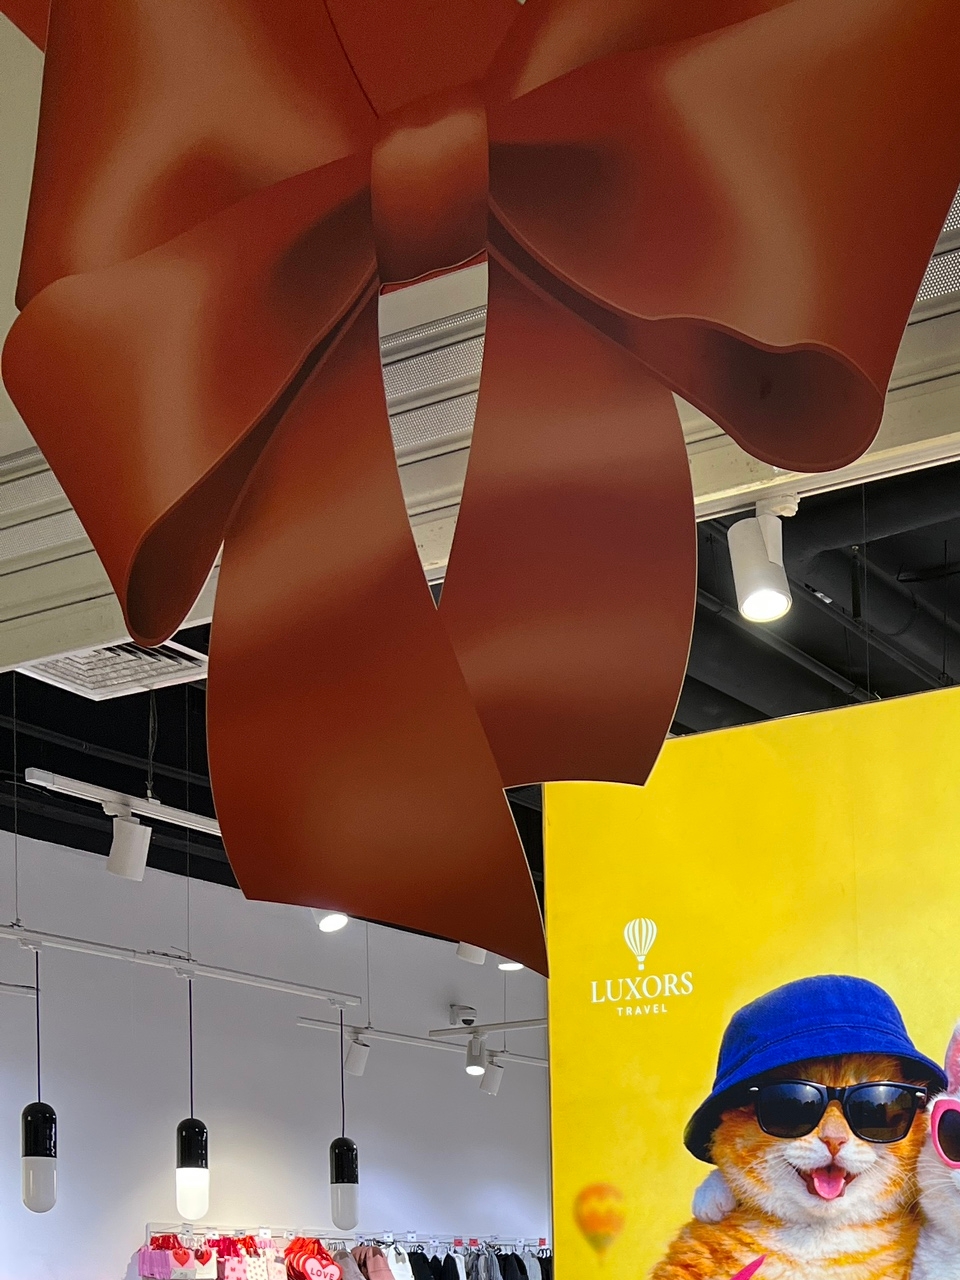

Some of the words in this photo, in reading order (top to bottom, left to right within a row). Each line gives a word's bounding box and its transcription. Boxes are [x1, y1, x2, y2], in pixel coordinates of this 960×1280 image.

[591, 971, 694, 1003] LUXORS
[617, 1003, 668, 1016] TRAVEL
[310, 1267, 335, 1280] LOVE
